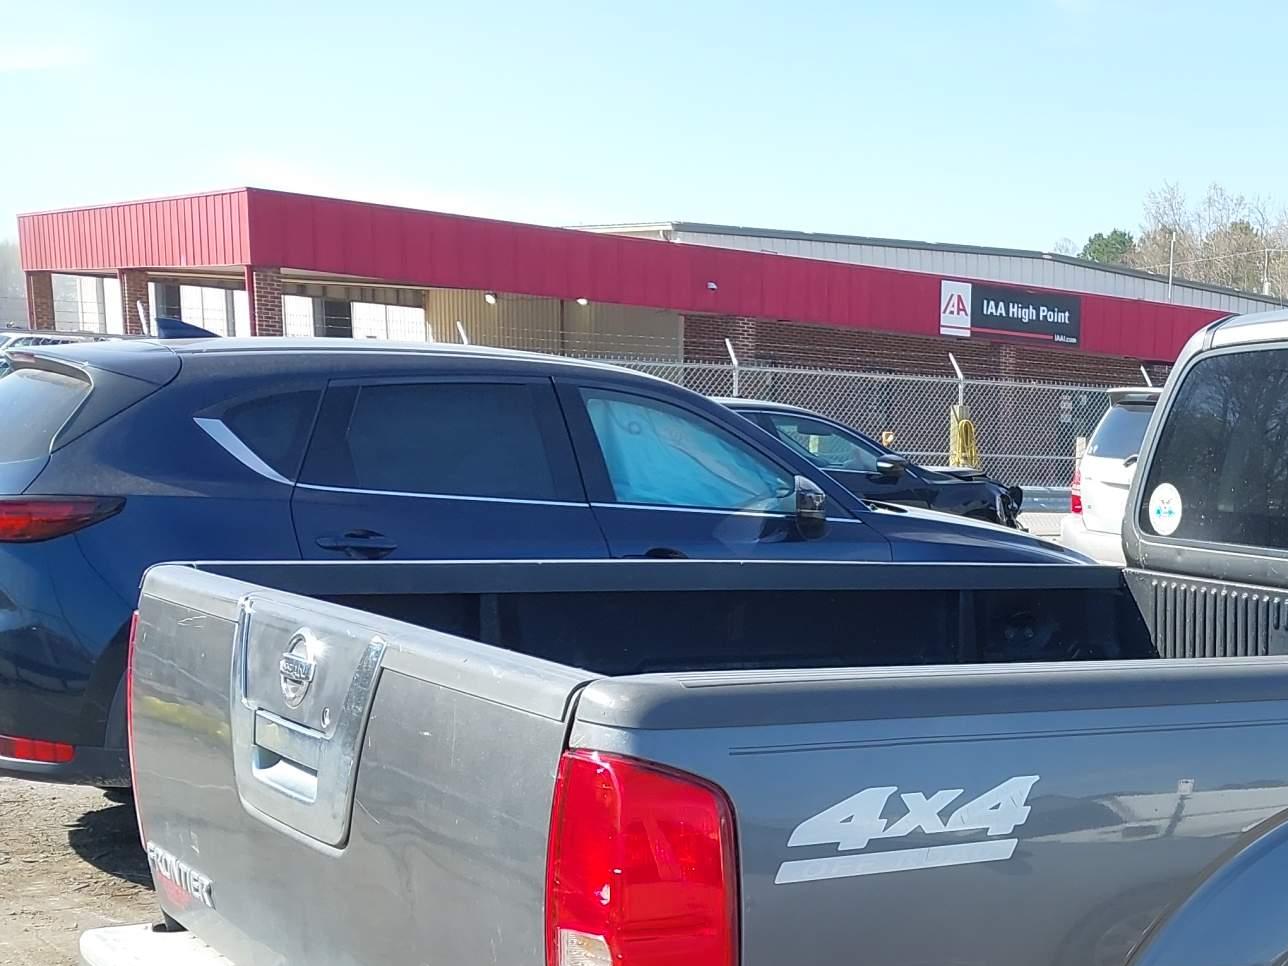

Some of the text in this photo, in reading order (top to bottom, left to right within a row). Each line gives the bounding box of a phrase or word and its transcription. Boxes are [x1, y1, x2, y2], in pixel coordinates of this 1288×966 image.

[983, 299, 1070, 324] IAA High Point
[146, 841, 213, 907] FRONTIER
